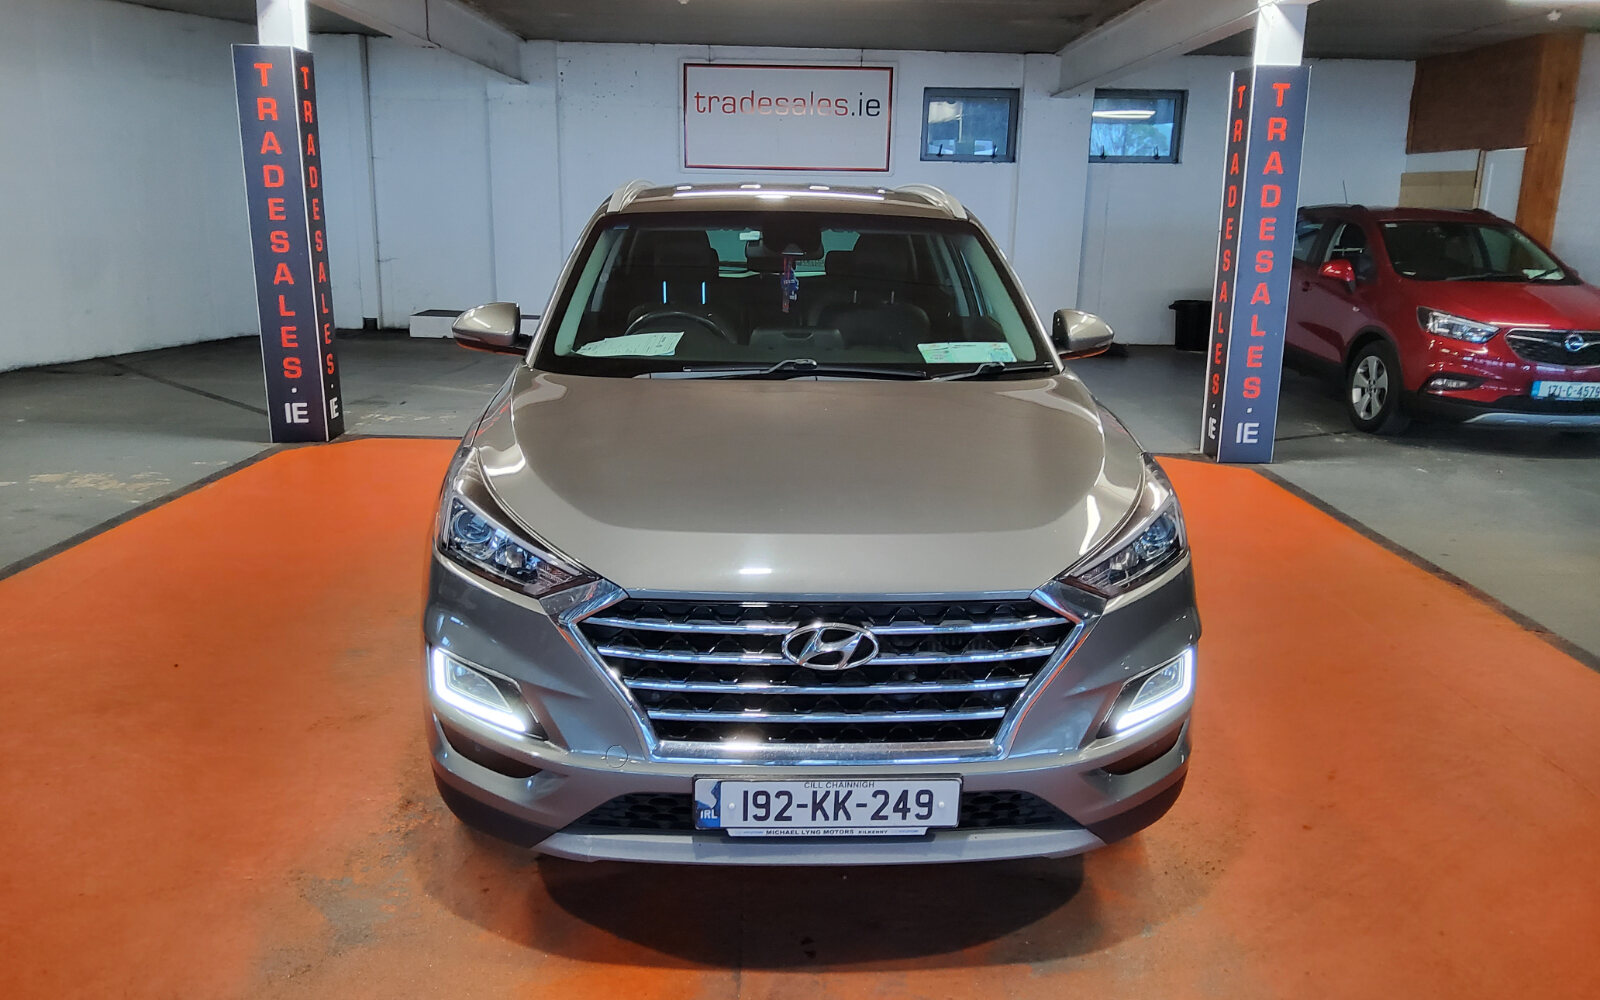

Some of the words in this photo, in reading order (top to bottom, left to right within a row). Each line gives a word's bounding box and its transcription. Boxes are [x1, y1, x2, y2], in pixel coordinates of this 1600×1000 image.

[694, 90, 881, 117] tradesales.ie
[825, 781, 875, 789] CHAINNIGH
[700, 809, 718, 819] IRL
[742, 789, 934, 821] 192-KK-249
